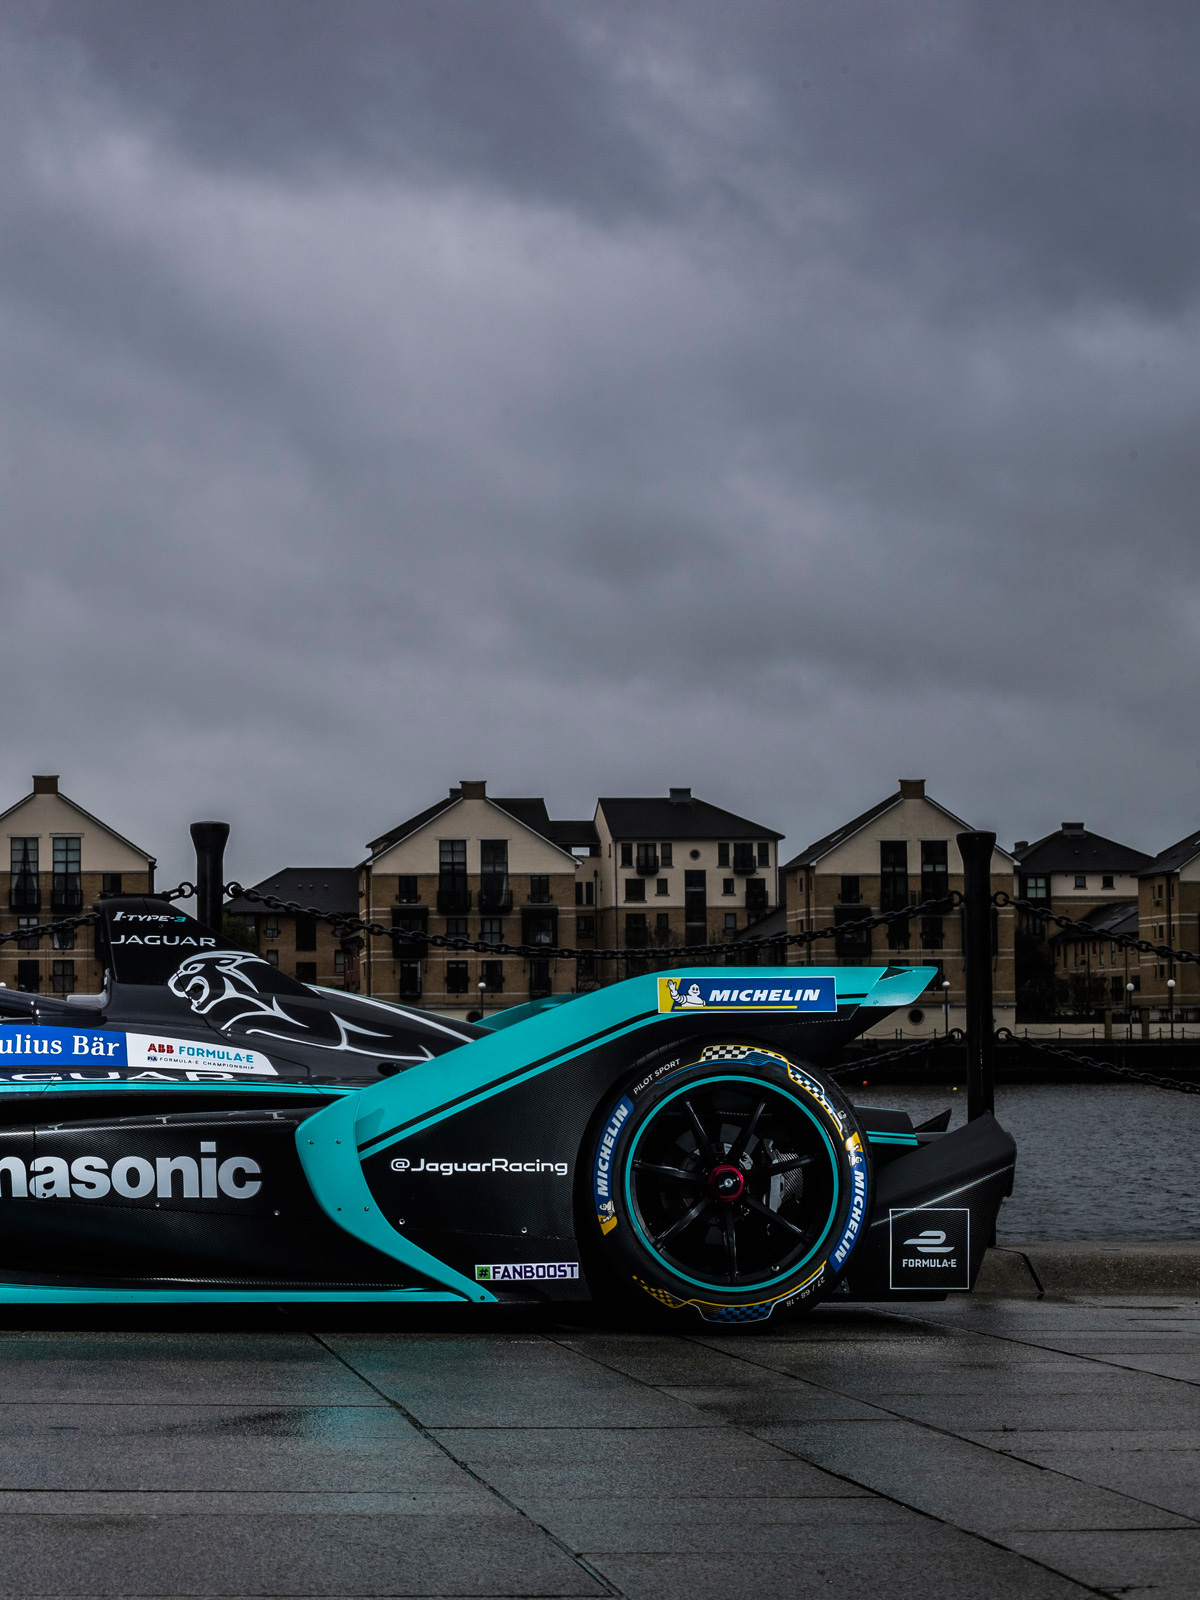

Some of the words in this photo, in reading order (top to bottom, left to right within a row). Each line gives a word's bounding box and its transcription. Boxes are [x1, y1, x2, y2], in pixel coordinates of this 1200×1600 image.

[112, 911, 187, 923] I-TYPE-3
[111, 934, 217, 947] JAGUAR
[708, 989, 821, 1002] MICHELIN
[71, 1035, 120, 1057] Bär
[147, 1043, 175, 1054] ABB
[202, 1061, 255, 1070] CHAMPIONSHIP
[633, 1075, 654, 1095] PILOT
[654, 1058, 681, 1078] SPORT
[597, 1104, 629, 1197] MICHELIN
[390, 1157, 568, 1176] @JaguarRacing
[834, 1170, 865, 1264] MICHELIN
